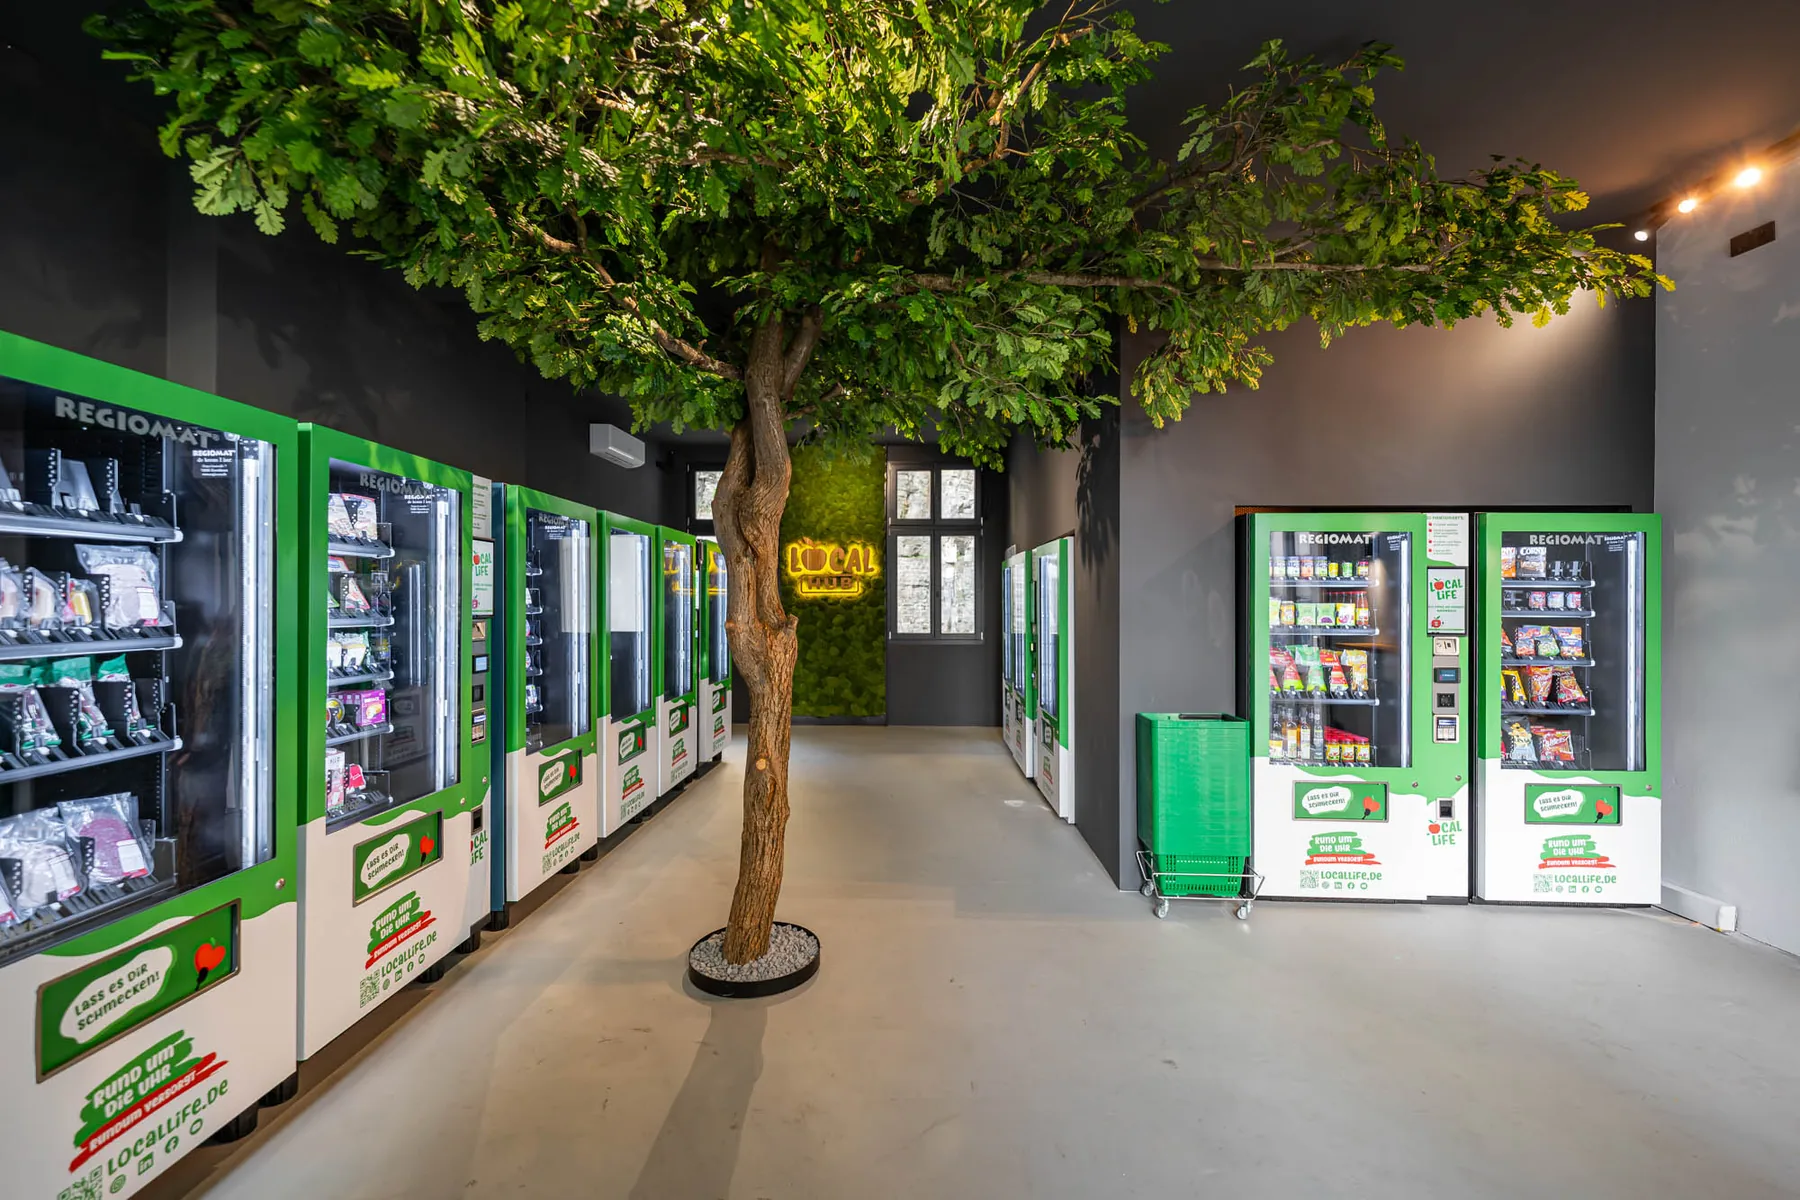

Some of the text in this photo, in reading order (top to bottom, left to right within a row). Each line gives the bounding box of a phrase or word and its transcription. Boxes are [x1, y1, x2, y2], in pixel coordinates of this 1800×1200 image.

[1299, 533, 1371, 545] REGIOMAT
[1529, 534, 1603, 546] REGIOMAT
[789, 544, 876, 574] LOCAL
[807, 576, 853, 590] HUB
[1429, 579, 1463, 592] LOCAL
[1436, 590, 1457, 601] LiFE
[1431, 834, 1456, 846] LiFE
[74, 990, 105, 1016] LaSS
[127, 963, 149, 982] DiR
[93, 1044, 174, 1109] RunD um
[104, 1063, 171, 1118] Die UHR
[107, 1079, 228, 1176] LOCaLLiFe.De
